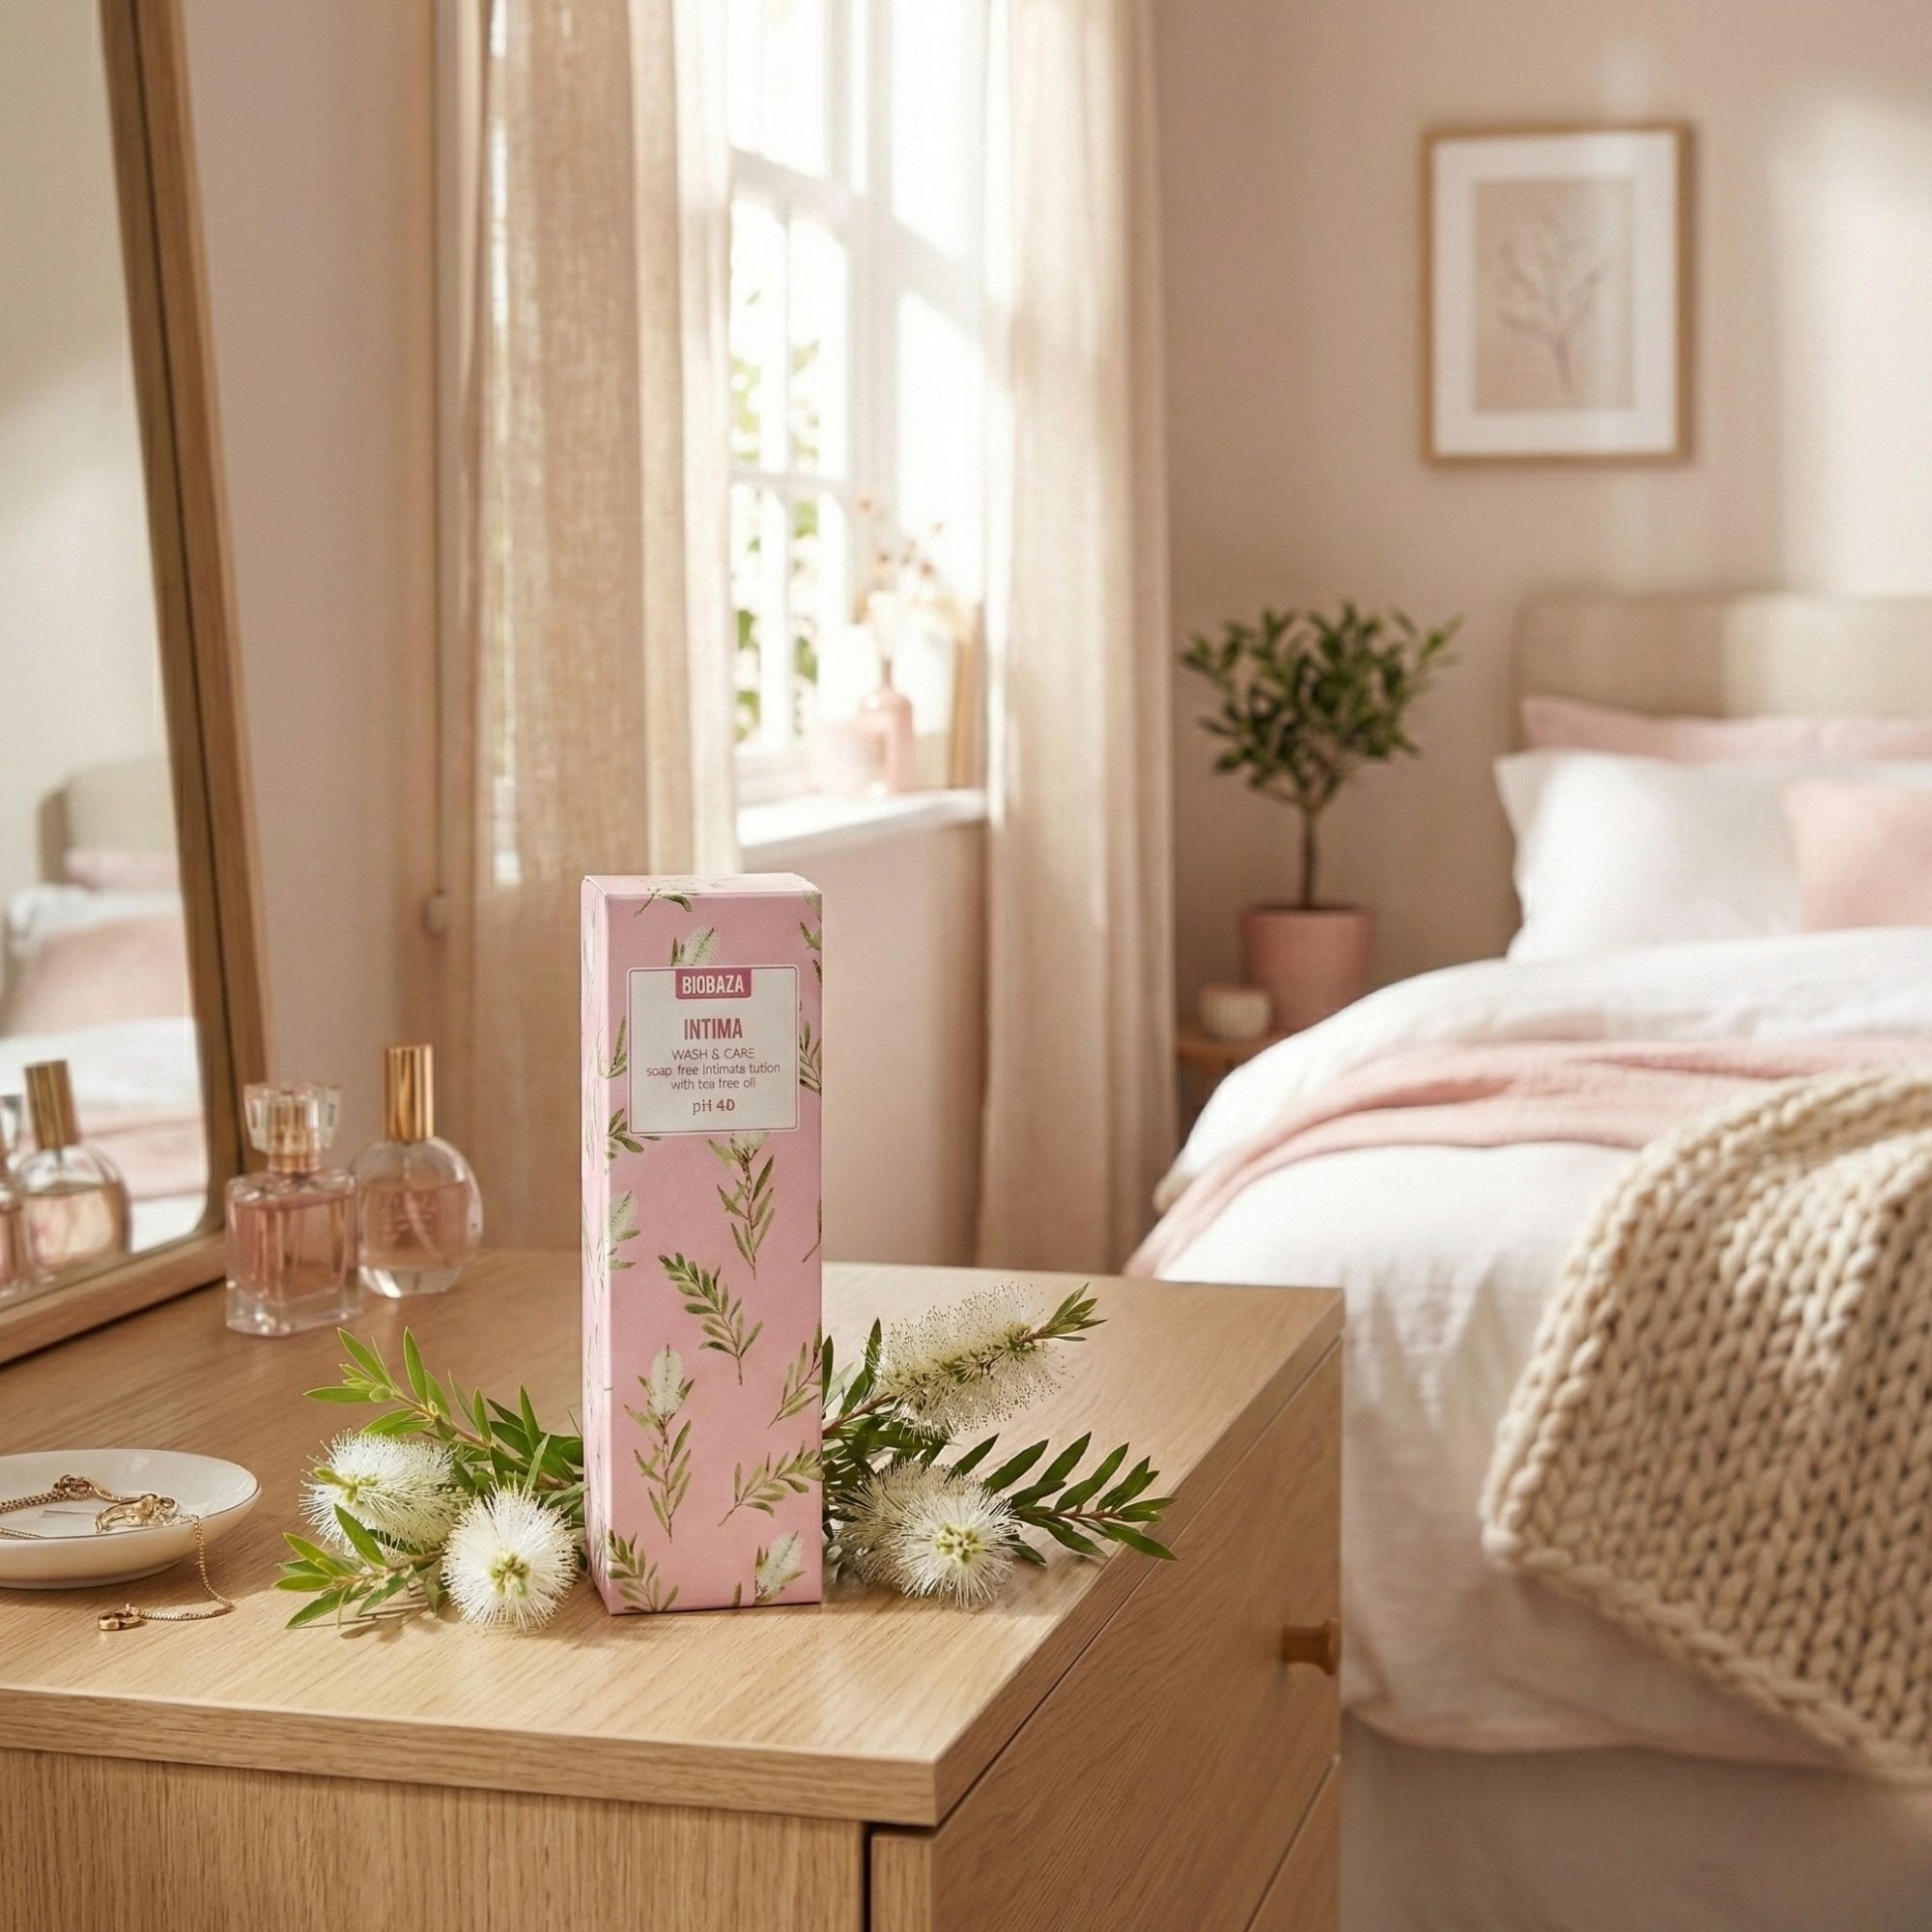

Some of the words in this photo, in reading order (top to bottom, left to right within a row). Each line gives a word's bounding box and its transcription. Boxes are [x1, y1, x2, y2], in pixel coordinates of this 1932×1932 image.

[683, 975, 744, 994] BIOBAZA
[684, 1018, 743, 1040] INTIMA
[671, 1048, 708, 1061] WASH
[711, 1048, 720, 1060] &
[724, 1047, 755, 1059] CARE
[646, 1065, 672, 1078] soap
[677, 1064, 698, 1075] free
[671, 1079, 695, 1091] with
